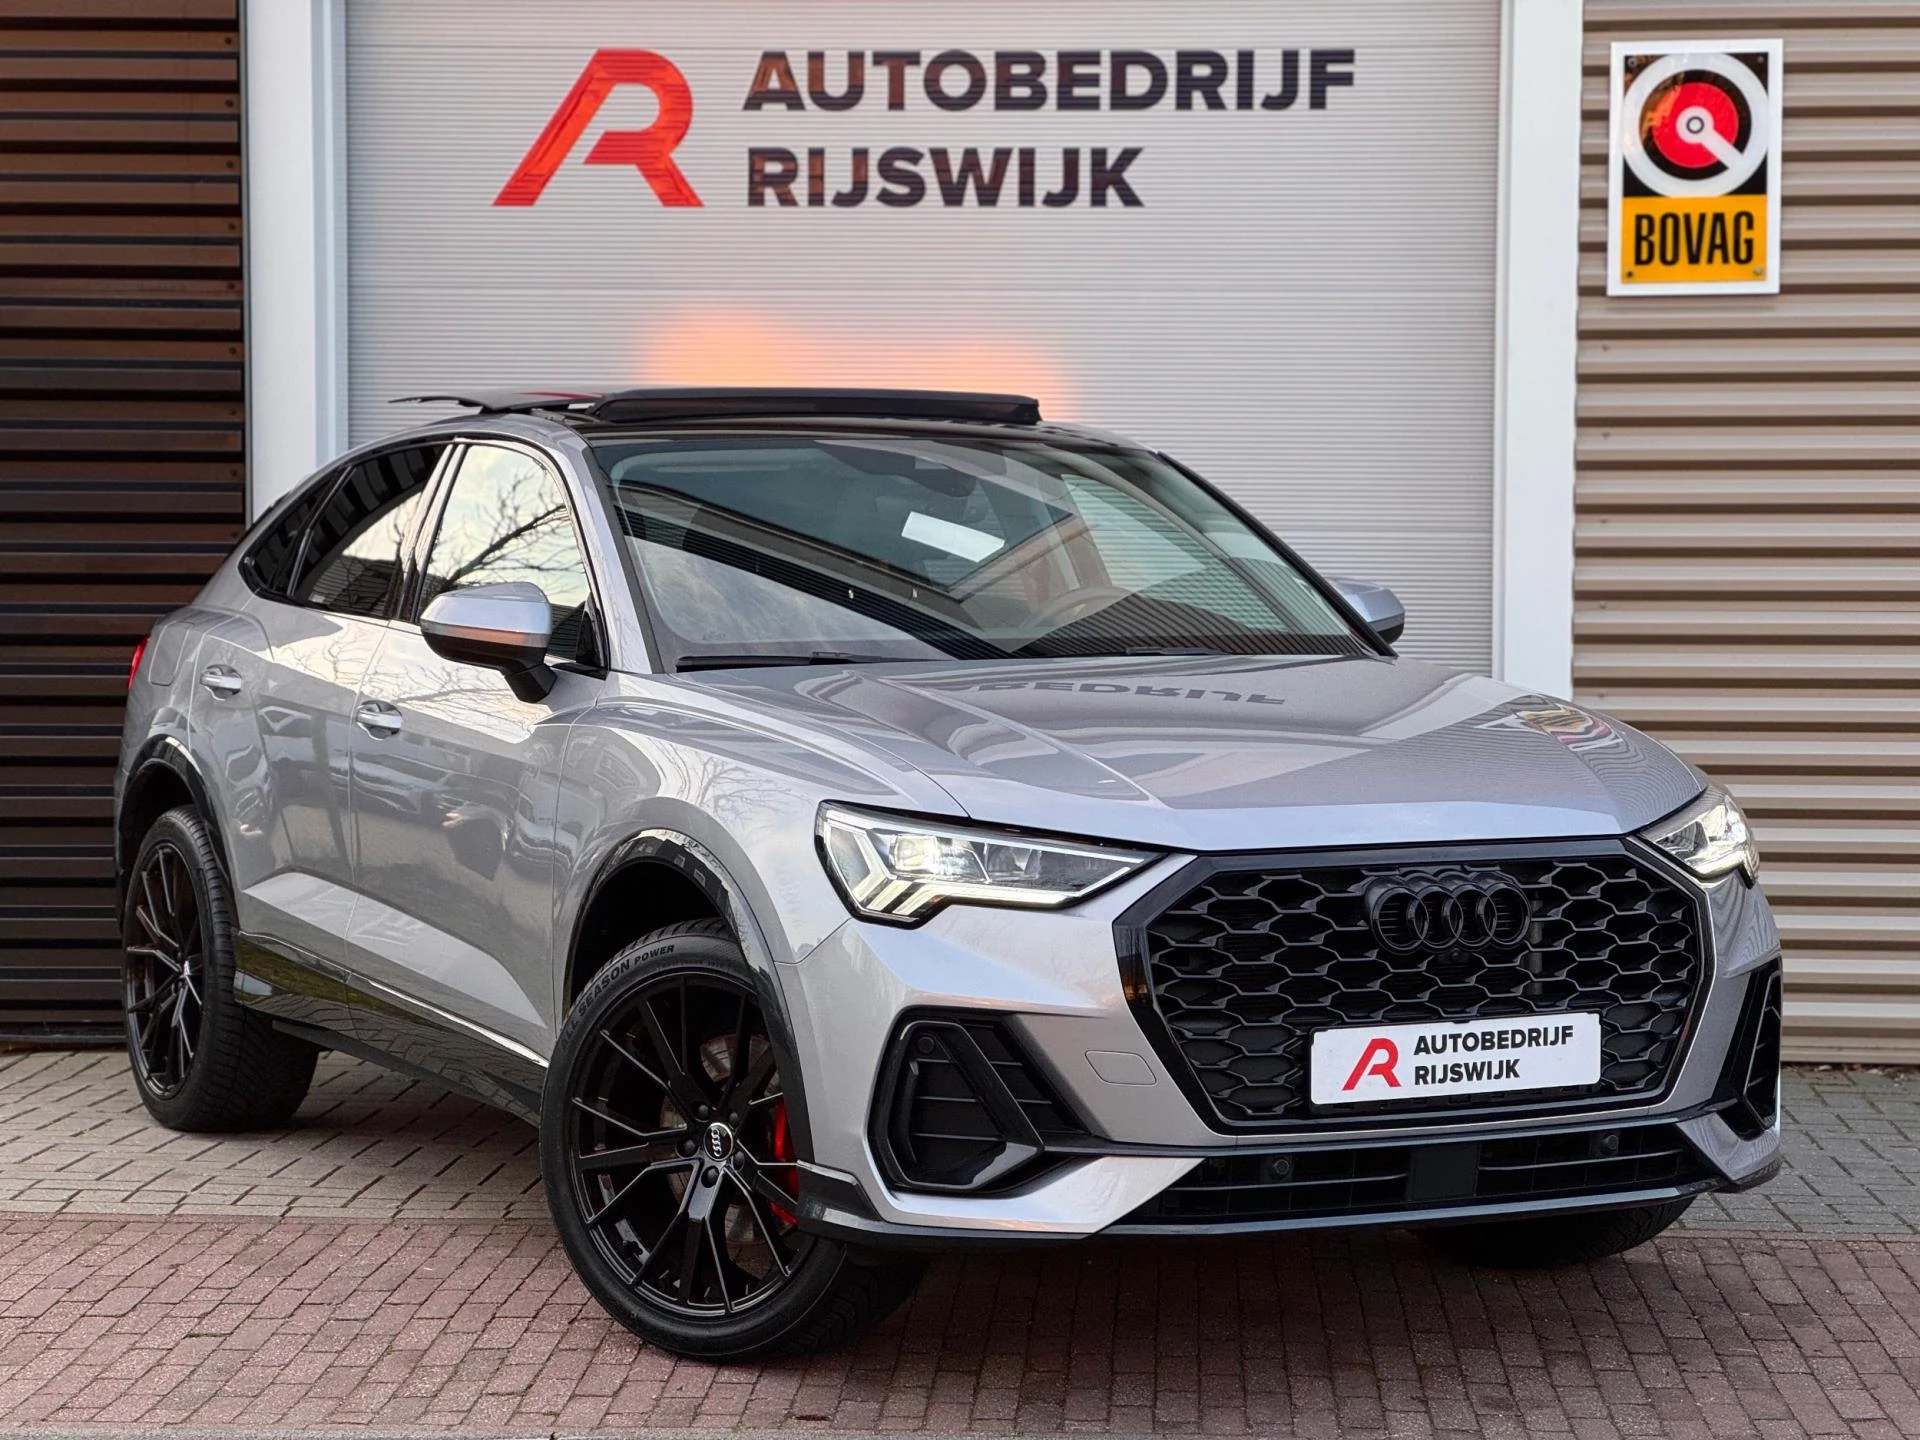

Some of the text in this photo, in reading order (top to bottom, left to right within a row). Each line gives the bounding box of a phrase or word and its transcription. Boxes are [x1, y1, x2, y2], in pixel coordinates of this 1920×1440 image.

[743, 48, 1356, 112] AUTOBEDRIJF
[747, 146, 1144, 208] RIJSWIJK
[1634, 211, 1755, 267] BOVAG
[577, 958, 631, 1017] SEASON
[633, 944, 675, 966] POWER
[1413, 1025, 1574, 1056] AUTOBEDRIJF
[1414, 1058, 1520, 1086] RIJSWIJK
